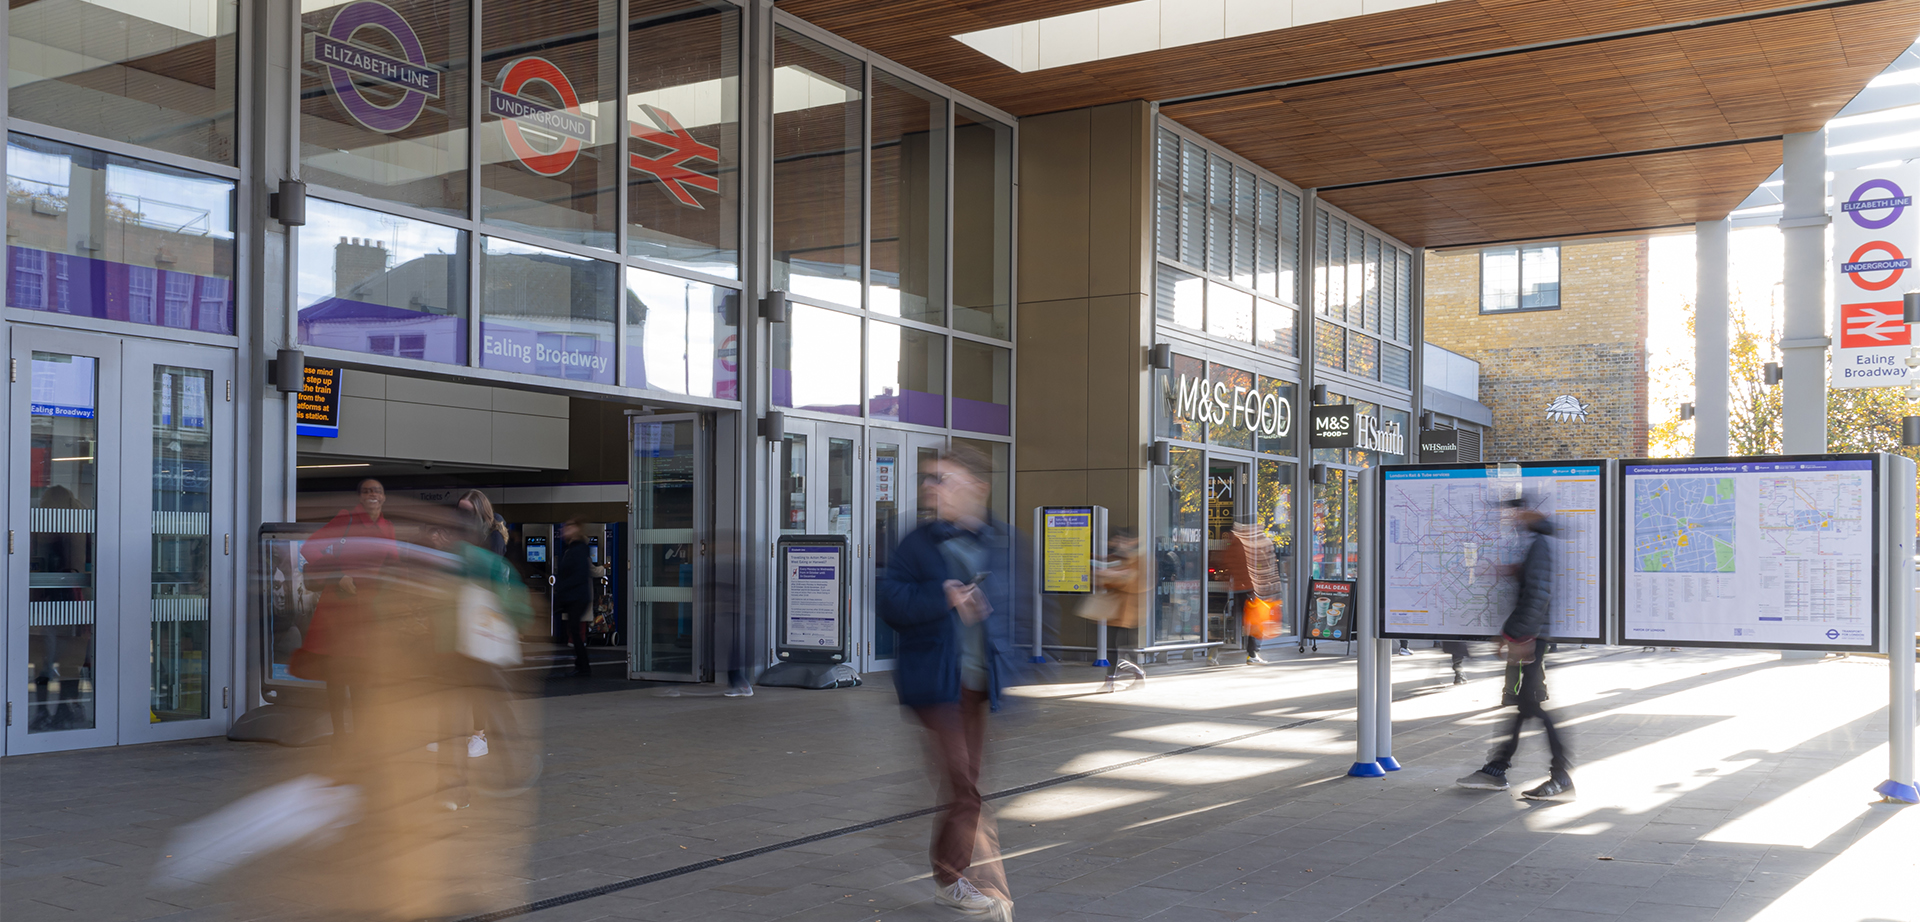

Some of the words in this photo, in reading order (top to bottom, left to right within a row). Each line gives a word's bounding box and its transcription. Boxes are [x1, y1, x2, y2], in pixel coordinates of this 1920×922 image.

[324, 43, 397, 78] ELIZABETH
[401, 67, 429, 88] LINE
[496, 97, 585, 135] UNDERGROUND
[1844, 200, 1888, 211] ELIZABETH
[1890, 198, 1909, 206] LINE
[1844, 260, 1908, 272] UNDERGROUND
[484, 335, 532, 364] Ealing
[536, 343, 608, 374] Broadway
[1857, 355, 1895, 366] Ealing
[317, 368, 334, 376] mind
[1845, 367, 1908, 378] Broadway
[306, 376, 322, 385] step
[323, 378, 333, 386] up
[315, 385, 332, 394] train
[298, 393, 313, 401] from
[1178, 373, 1229, 425] M&S
[1233, 385, 1291, 437] FOOD
[31, 405, 54, 415] Ealing
[55, 407, 91, 417] Broadway
[305, 413, 329, 421] station.
[1316, 416, 1350, 431] M&S
[1356, 413, 1404, 455] HSmith
[1421, 443, 1457, 451] WHSmith
[420, 493, 443, 501] Tickets
